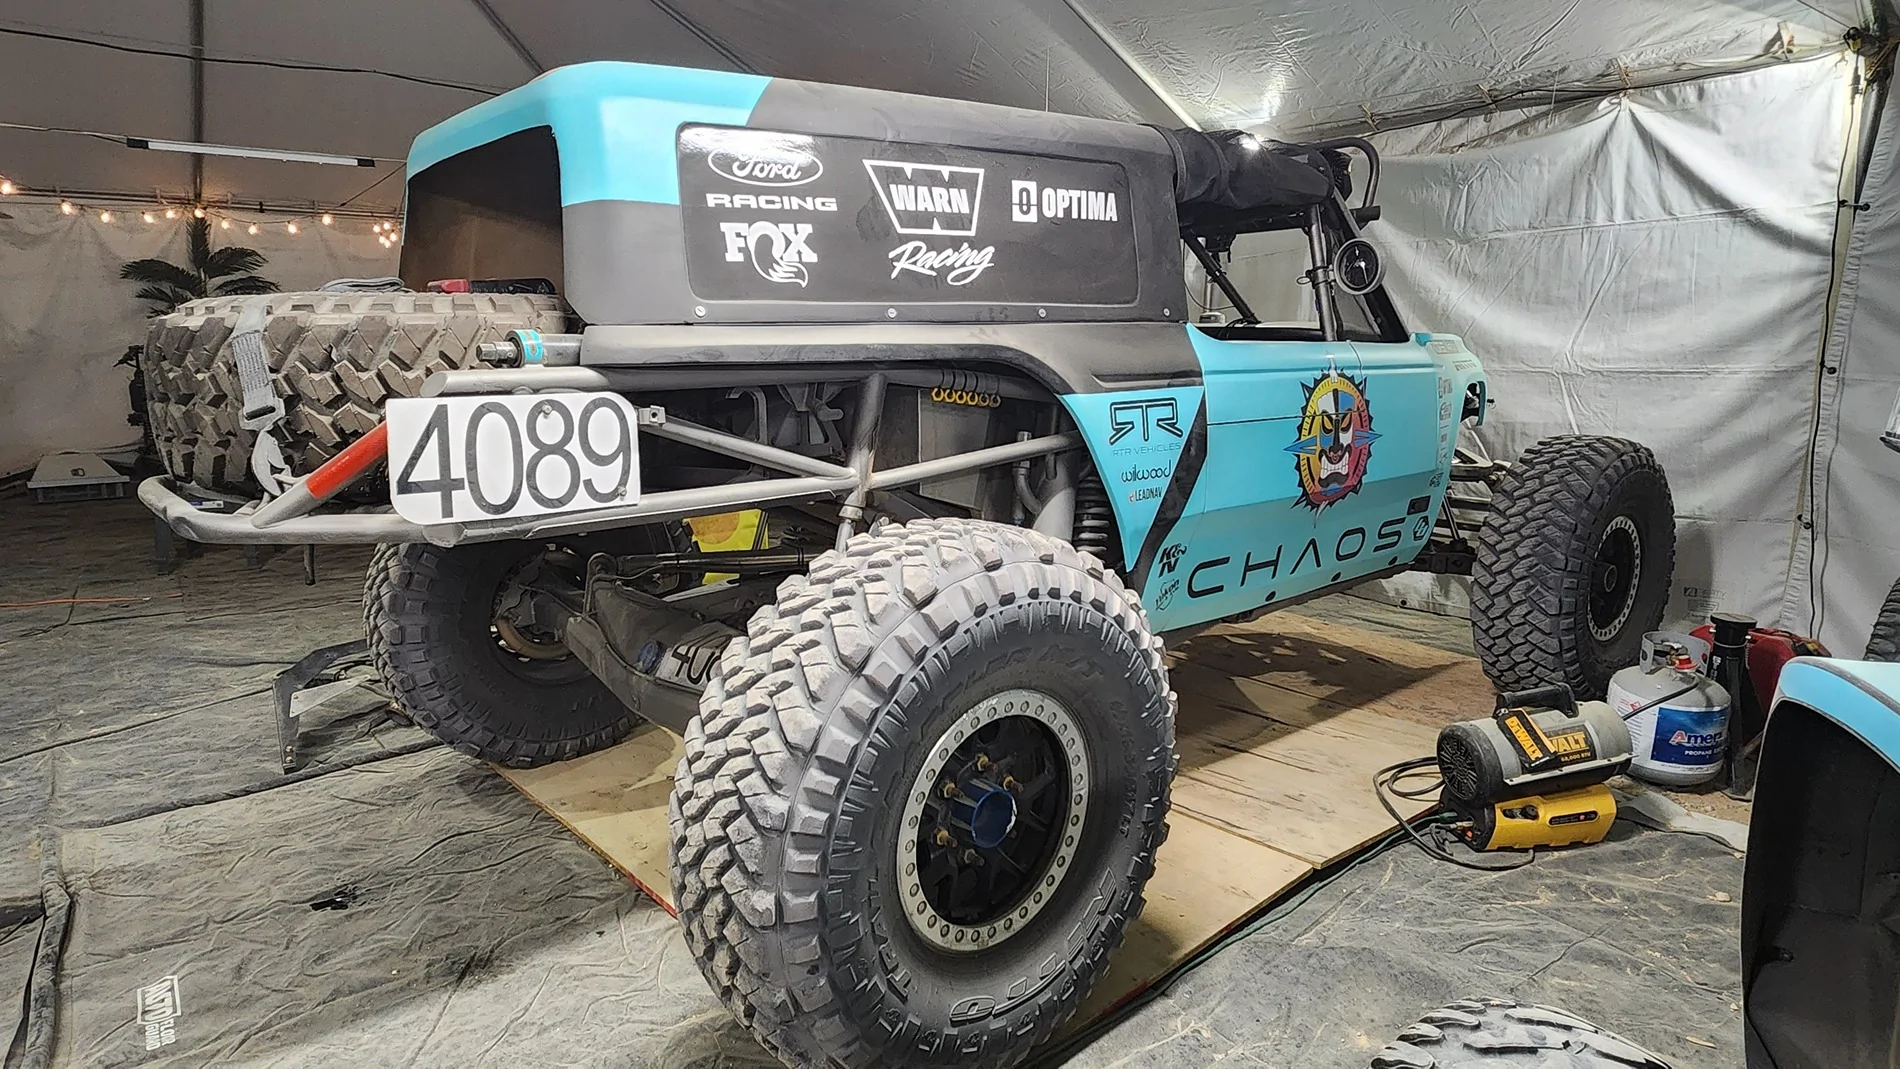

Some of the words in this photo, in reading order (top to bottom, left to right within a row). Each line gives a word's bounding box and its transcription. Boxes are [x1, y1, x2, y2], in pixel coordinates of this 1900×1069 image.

[732, 152, 801, 180] Ford
[706, 193, 838, 211] RACING
[889, 184, 970, 214] WARN
[1042, 187, 1118, 222] OPTIMA
[719, 221, 818, 284] FOX
[888, 240, 996, 285] Racing
[396, 397, 632, 519] 4089
[1113, 448, 1132, 456] RTR
[1134, 442, 1181, 455] VEHICLES
[1121, 459, 1171, 482] wilwood
[1135, 486, 1163, 501] LEADNAV
[1187, 516, 1406, 599] CHAOS
[144, 979, 173, 1021] AUTO
